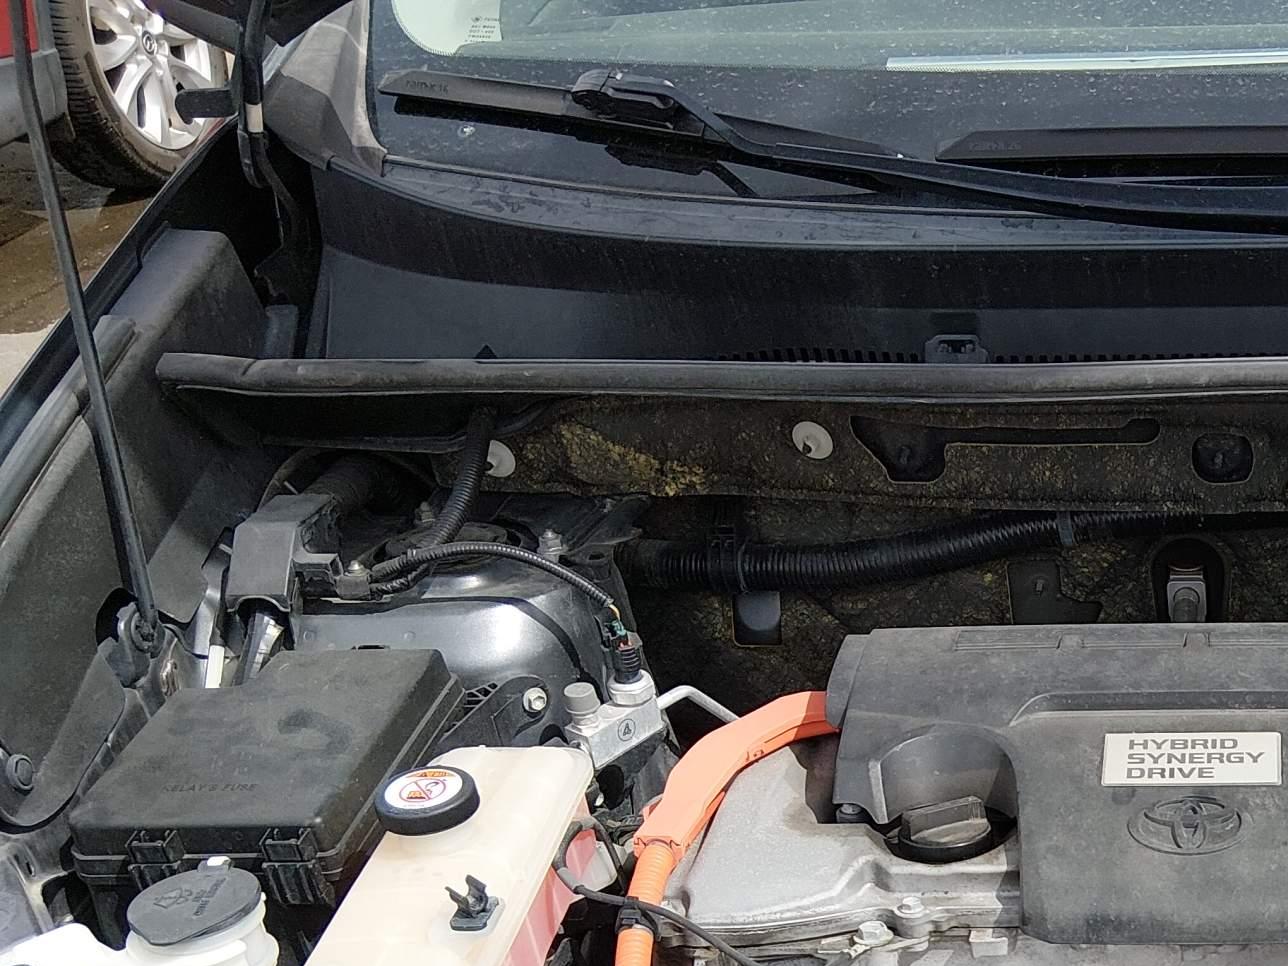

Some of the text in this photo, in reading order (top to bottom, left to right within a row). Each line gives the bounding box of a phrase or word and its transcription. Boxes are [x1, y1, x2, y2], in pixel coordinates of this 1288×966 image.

[1128, 738, 1239, 750] HYBRID
[1127, 751, 1265, 765] SYNERGY
[1126, 767, 1216, 779] DRIVE
